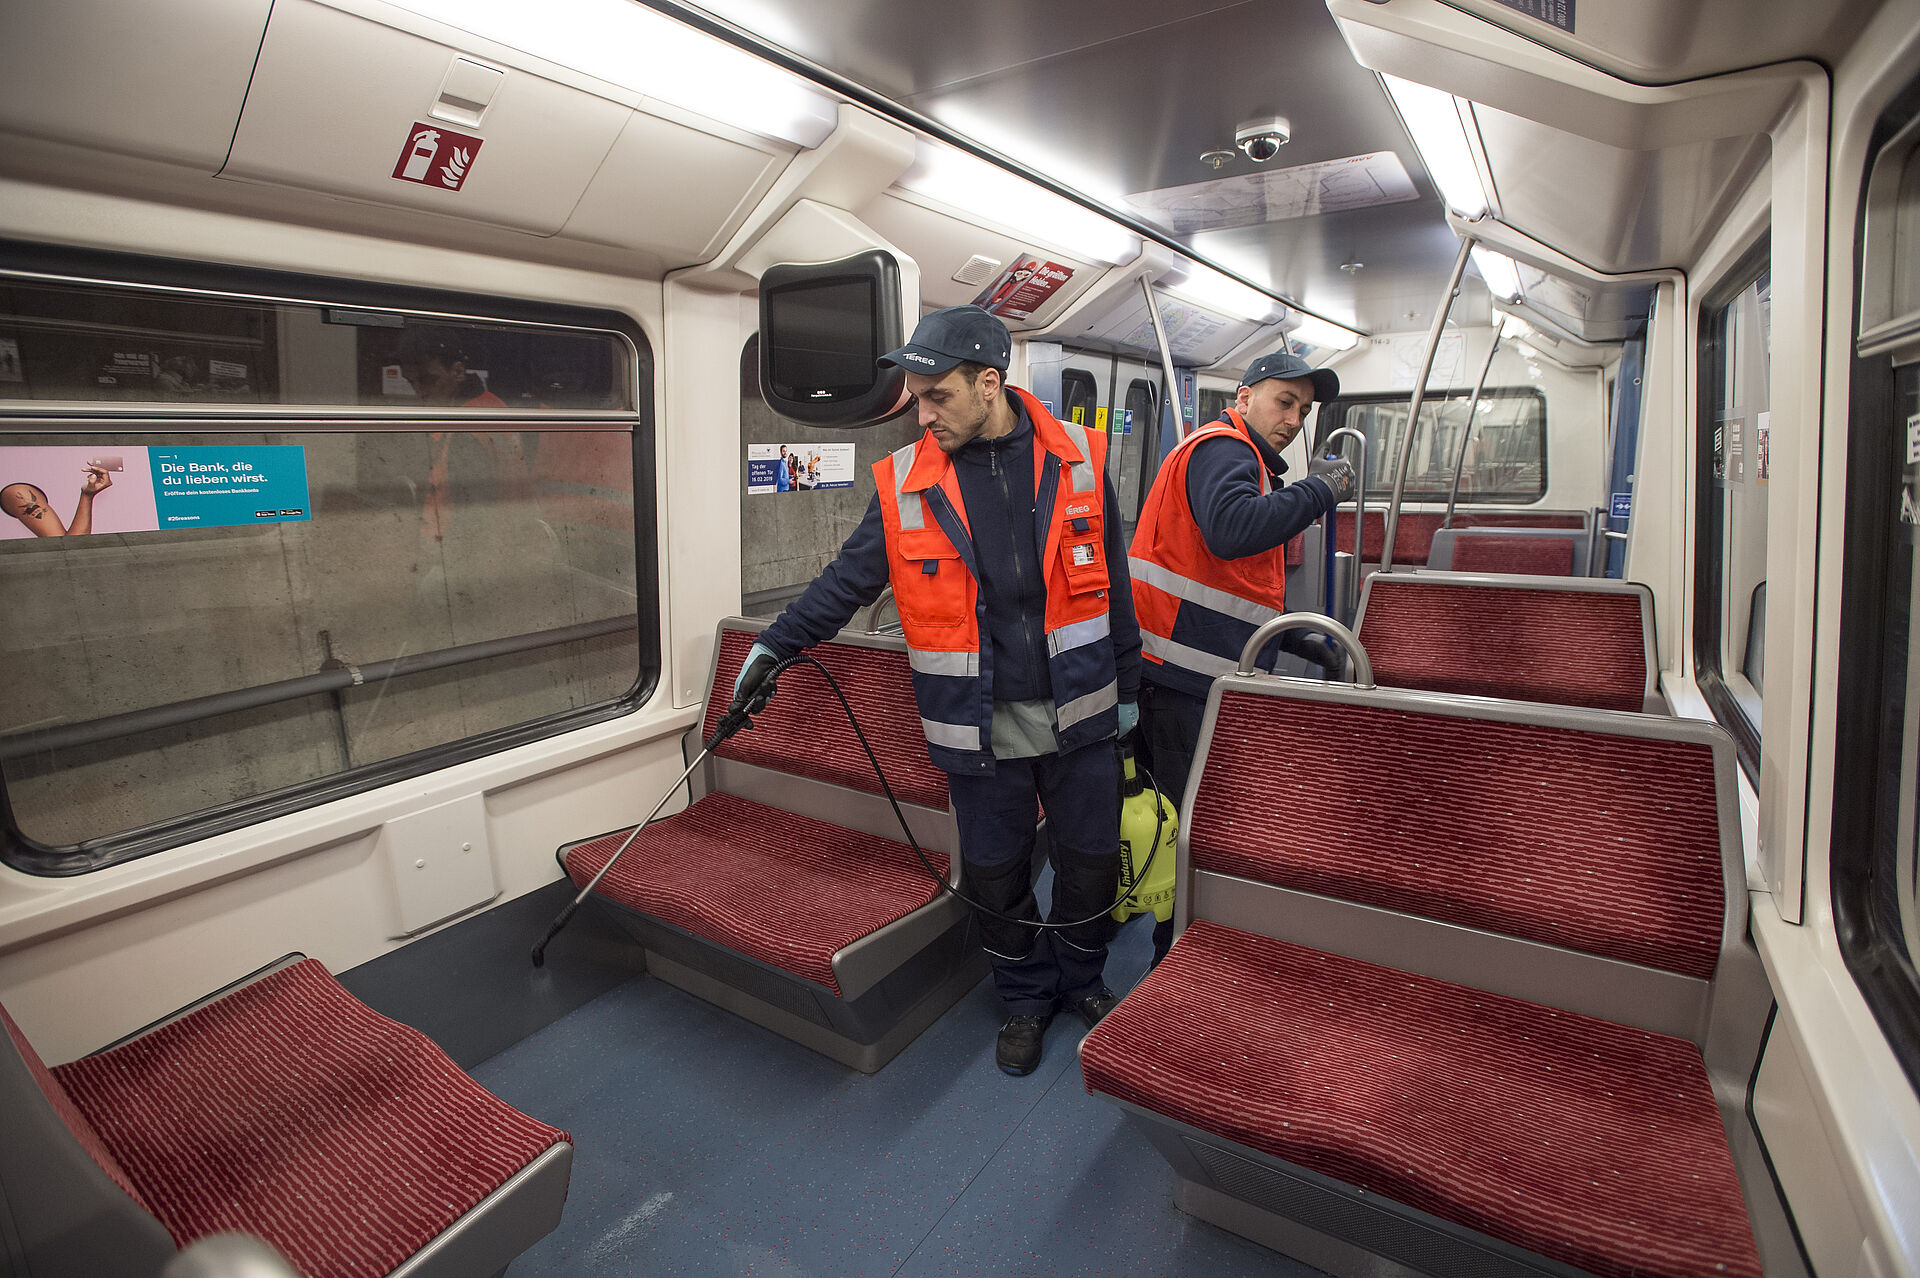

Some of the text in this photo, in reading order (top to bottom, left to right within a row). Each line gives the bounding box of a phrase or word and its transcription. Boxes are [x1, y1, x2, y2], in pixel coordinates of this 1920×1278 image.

[903, 352, 936, 366] TEREG
[161, 461, 253, 473] Die Bank, die
[162, 473, 269, 485] du lieben wirst.
[1065, 504, 1090, 516] TEREG
